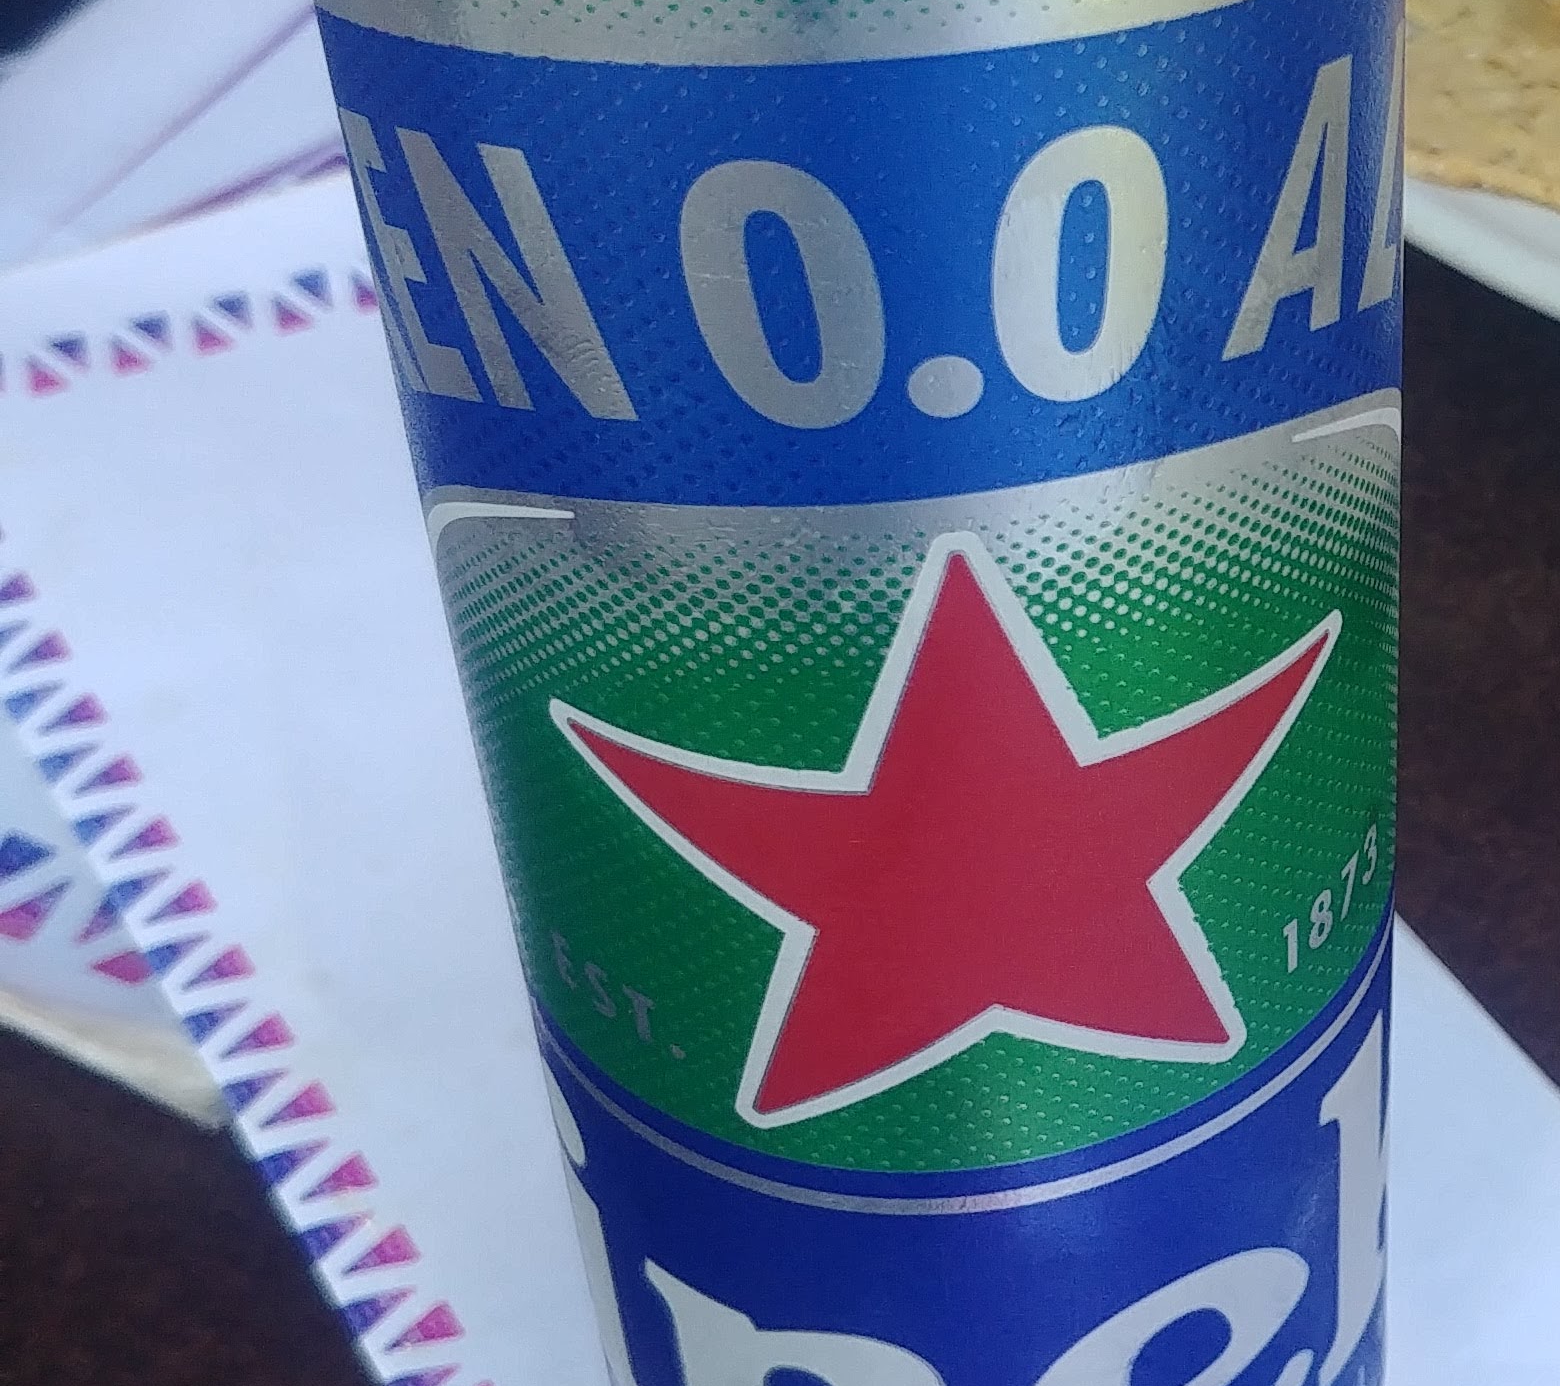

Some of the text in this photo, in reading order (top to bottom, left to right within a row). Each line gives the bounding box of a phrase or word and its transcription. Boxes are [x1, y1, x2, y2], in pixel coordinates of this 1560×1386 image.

[679, 124, 1169, 431] 0.0
[1282, 821, 1379, 975] 1873
[550, 929, 688, 1061] EST.
